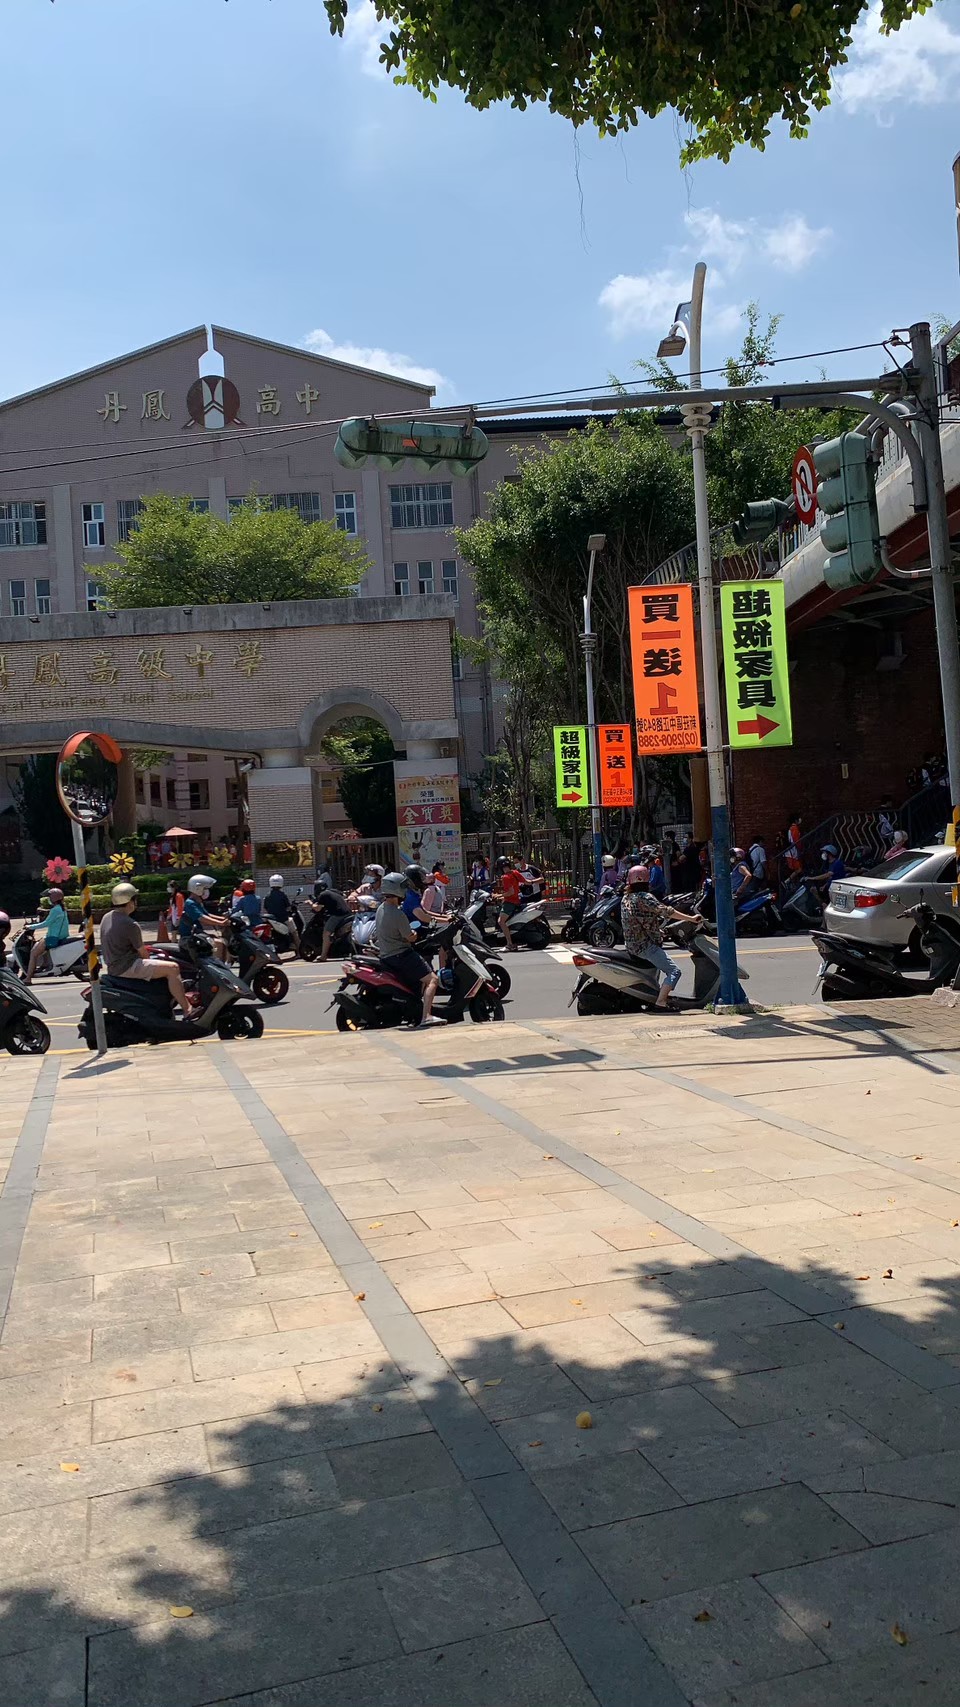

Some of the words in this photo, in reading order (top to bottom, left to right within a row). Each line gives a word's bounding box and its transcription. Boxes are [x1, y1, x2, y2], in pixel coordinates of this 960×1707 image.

[96, 389, 171, 423] 丹鳳
[256, 383, 320, 416] 高中
[560, 731, 582, 788] 超級家具
